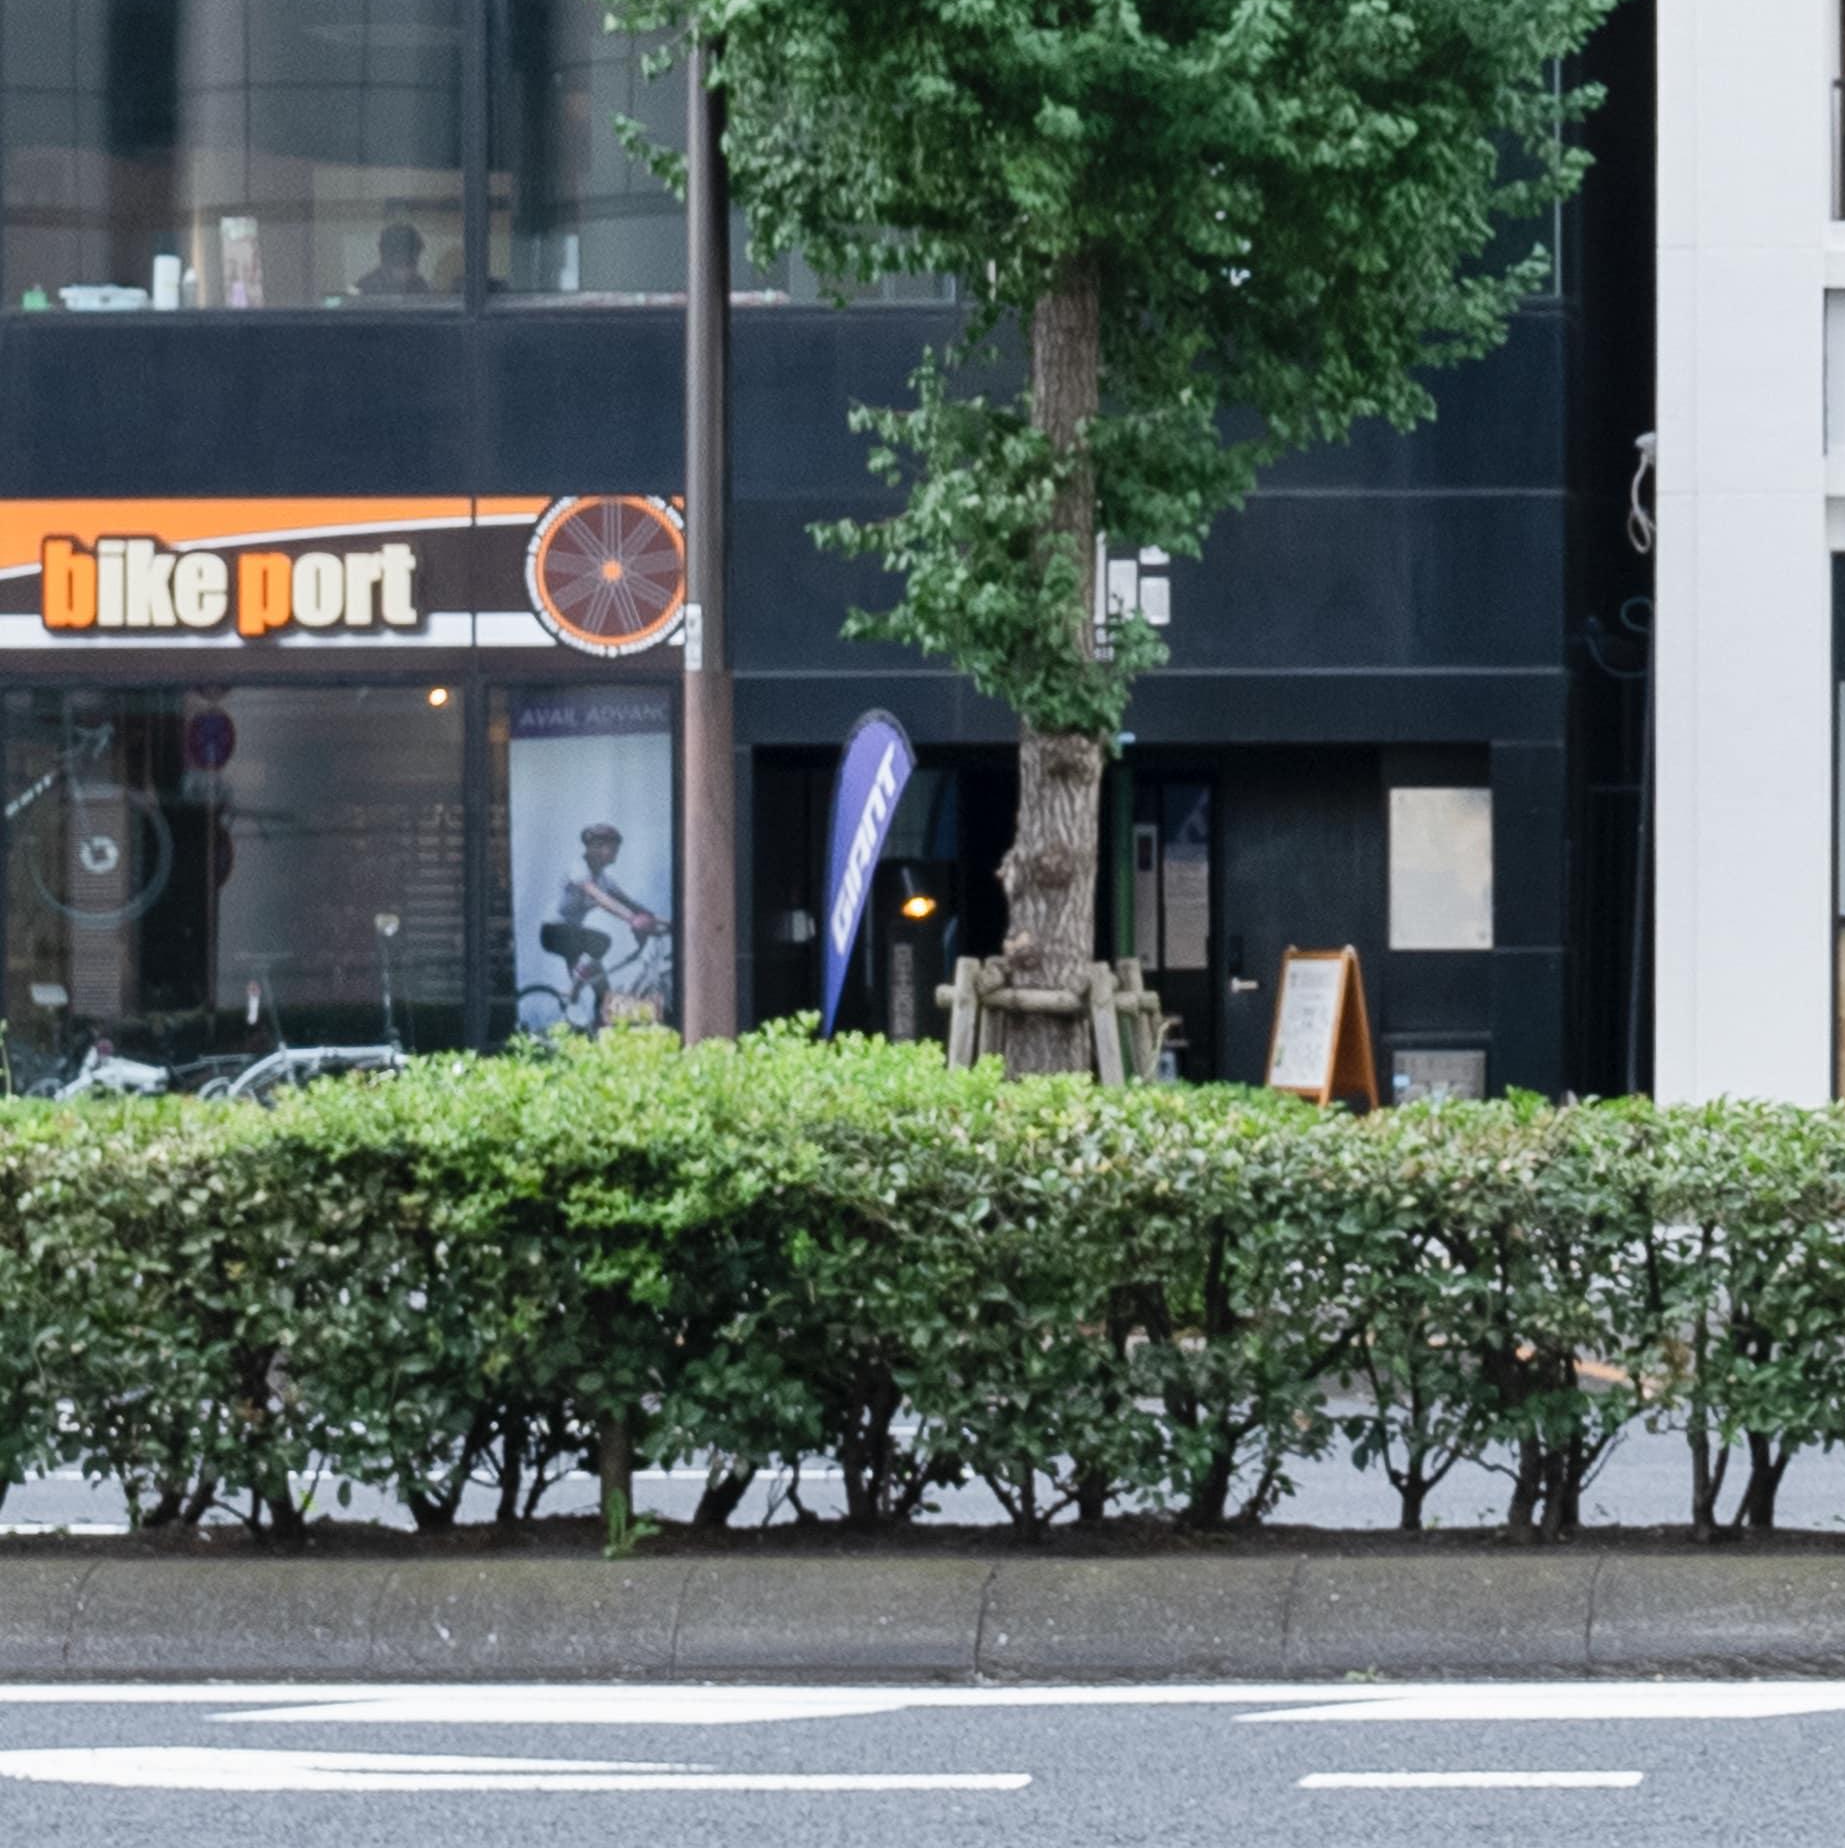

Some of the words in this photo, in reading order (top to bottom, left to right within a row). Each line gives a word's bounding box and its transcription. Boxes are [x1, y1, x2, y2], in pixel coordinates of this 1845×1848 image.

[44, 538, 228, 628] bike
[238, 543, 417, 636] port
[832, 740, 896, 955] GIANT
